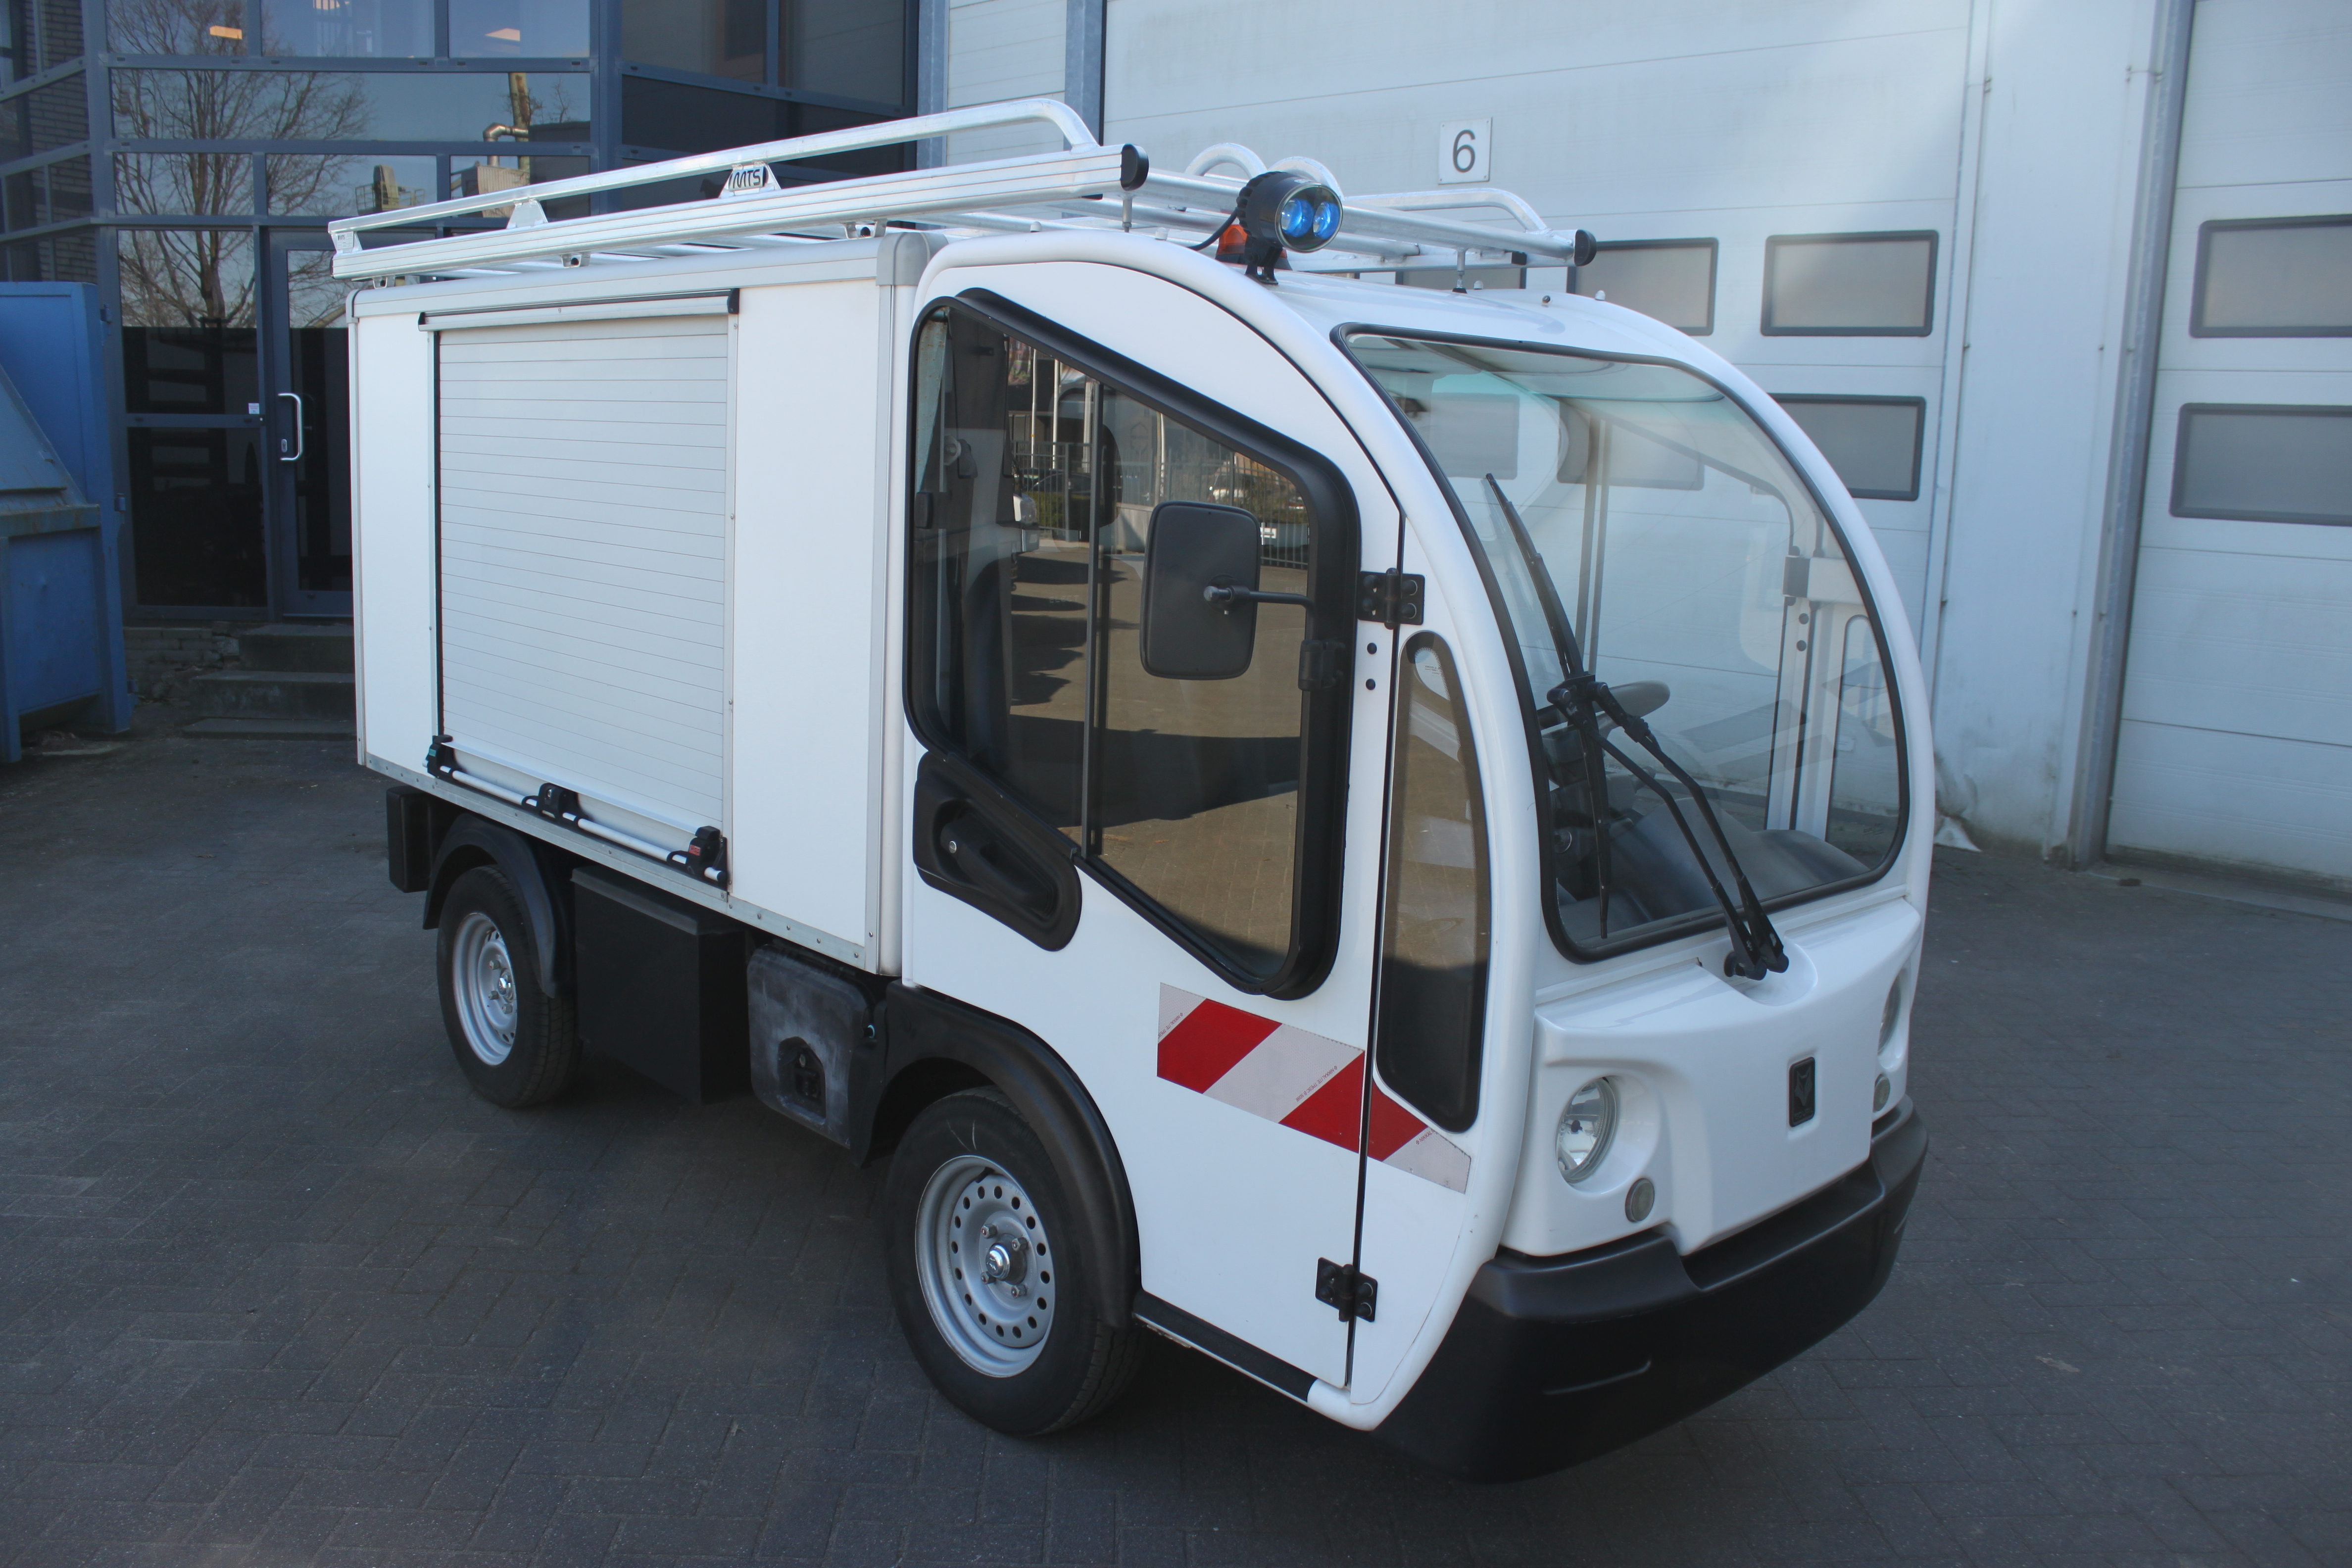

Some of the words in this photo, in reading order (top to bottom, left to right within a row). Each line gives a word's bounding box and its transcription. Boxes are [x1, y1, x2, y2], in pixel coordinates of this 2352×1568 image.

[1453, 129, 1475, 173] 6
[733, 169, 761, 189] MTS
[1317, 1068, 1334, 1084] NIKKALITE
